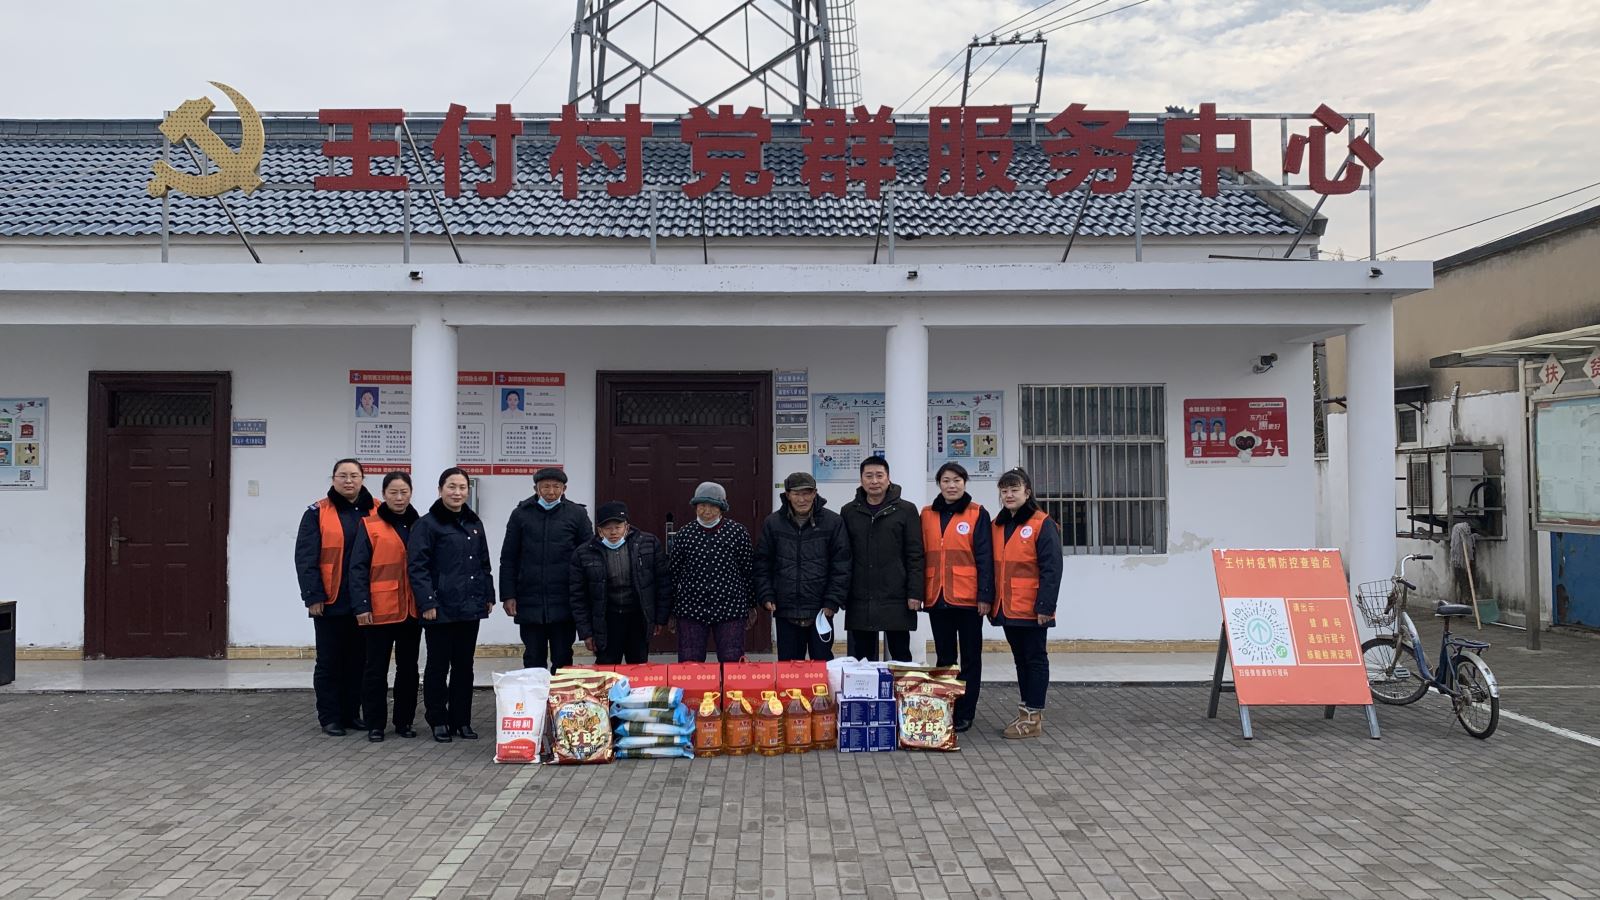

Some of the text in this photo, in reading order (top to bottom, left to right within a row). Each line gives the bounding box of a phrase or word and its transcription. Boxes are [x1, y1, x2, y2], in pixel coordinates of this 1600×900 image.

[314, 102, 1384, 200] 王付村党群服务中心
[1545, 363, 1559, 384] 扶
[1224, 556, 1332, 569] 王付村疫情防控查验点
[503, 719, 531, 729] 五得利
